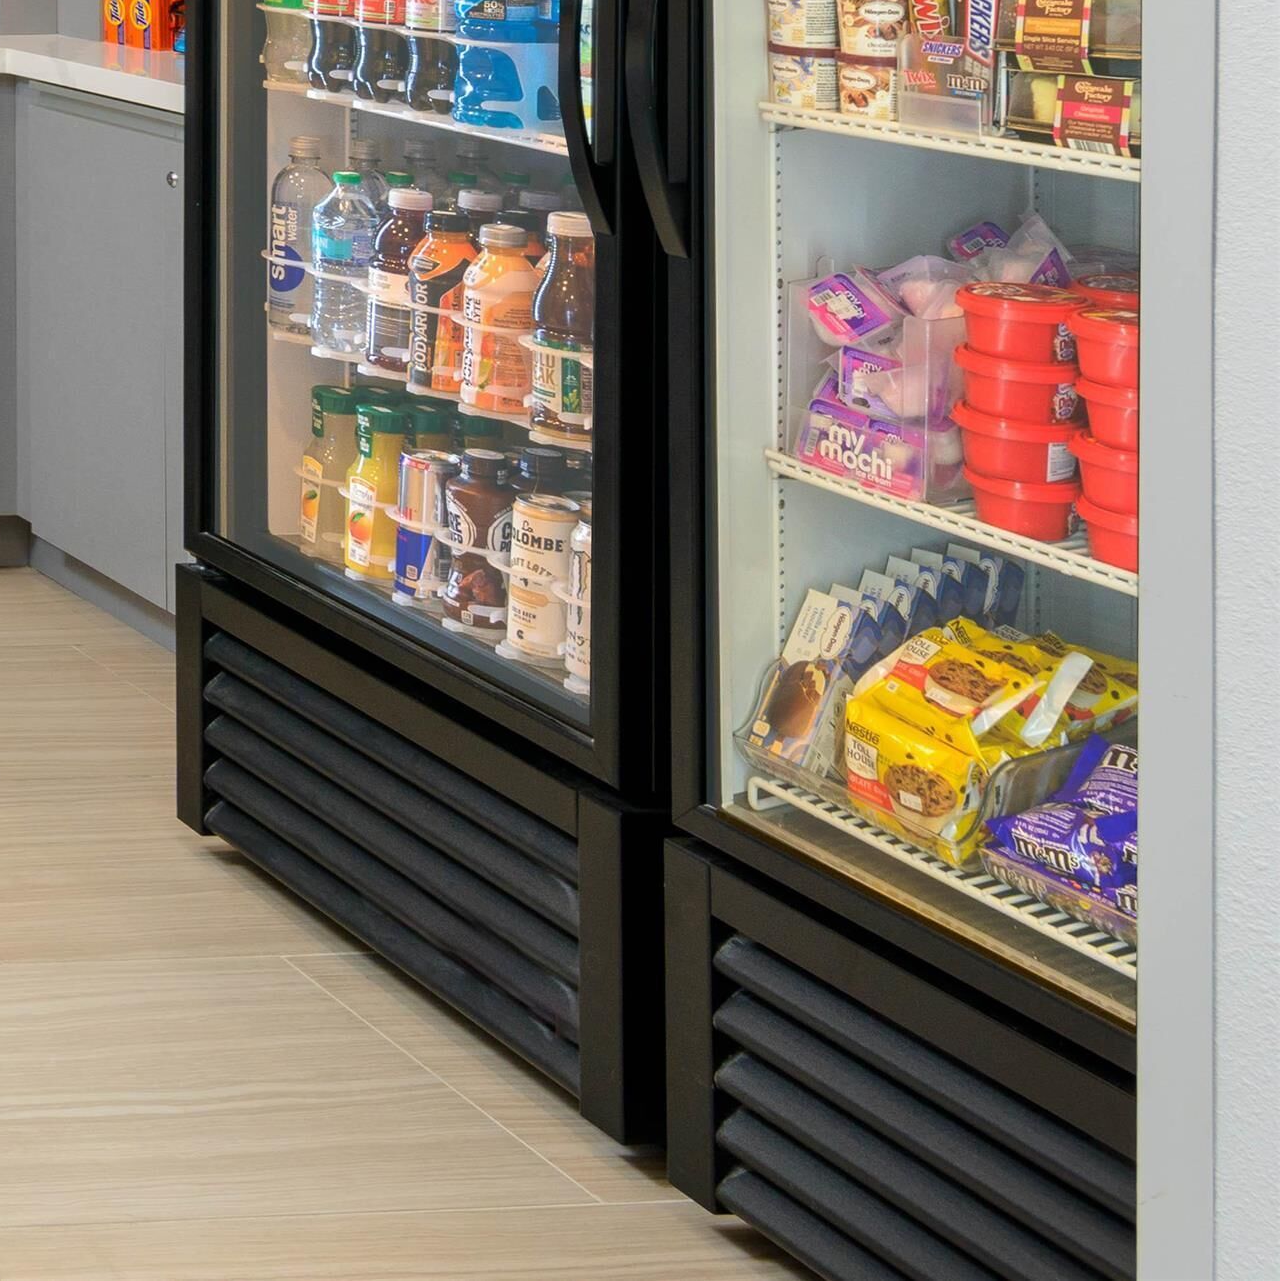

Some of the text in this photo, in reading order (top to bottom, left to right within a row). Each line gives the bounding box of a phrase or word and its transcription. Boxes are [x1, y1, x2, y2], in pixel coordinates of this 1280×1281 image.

[135, 1, 147, 26] Tide
[921, 41, 964, 57] SNICKERS
[271, 205, 288, 281] smart
[820, 434, 894, 480] mochi
